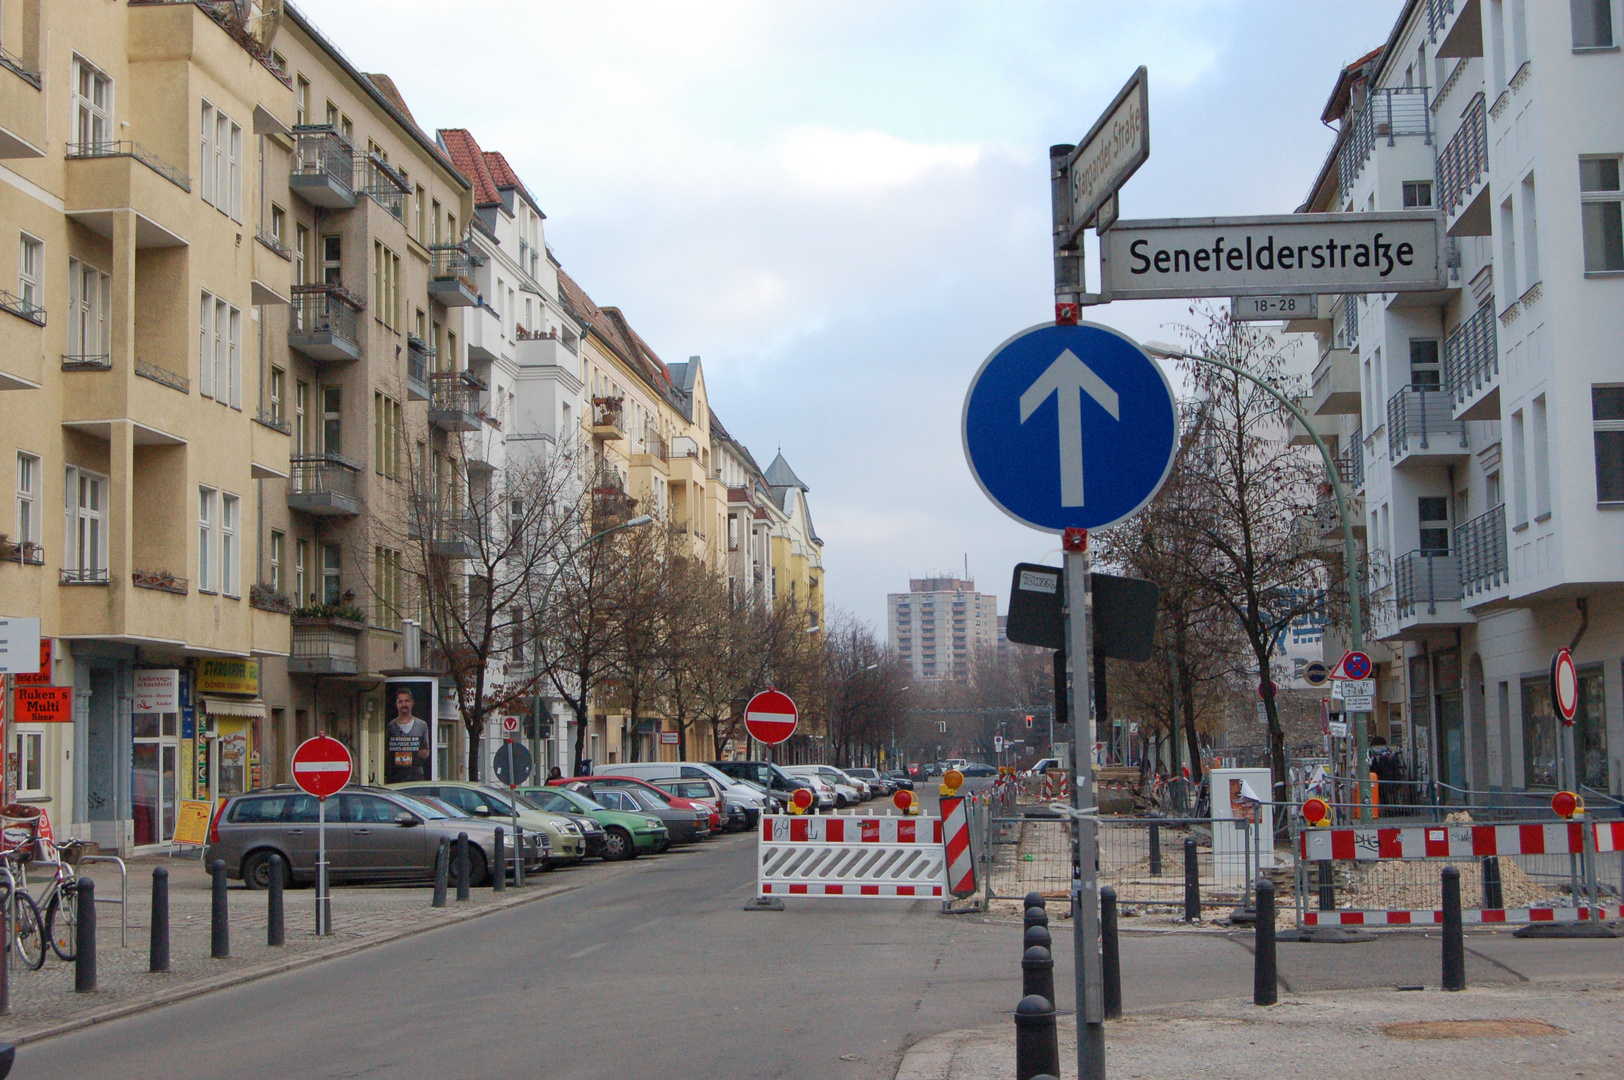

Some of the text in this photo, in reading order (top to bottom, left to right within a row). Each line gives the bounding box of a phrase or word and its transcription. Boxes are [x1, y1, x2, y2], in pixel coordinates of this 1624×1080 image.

[1074, 139, 1111, 203] Stargarder
[1113, 104, 1140, 158] Straße
[1130, 233, 1414, 277] Senefelderstraße
[1254, 299, 1296, 312] 18-28
[204, 680, 226, 689] DÖNER
[27, 701, 60, 712] Multi
[32, 713, 54, 721] Shop
